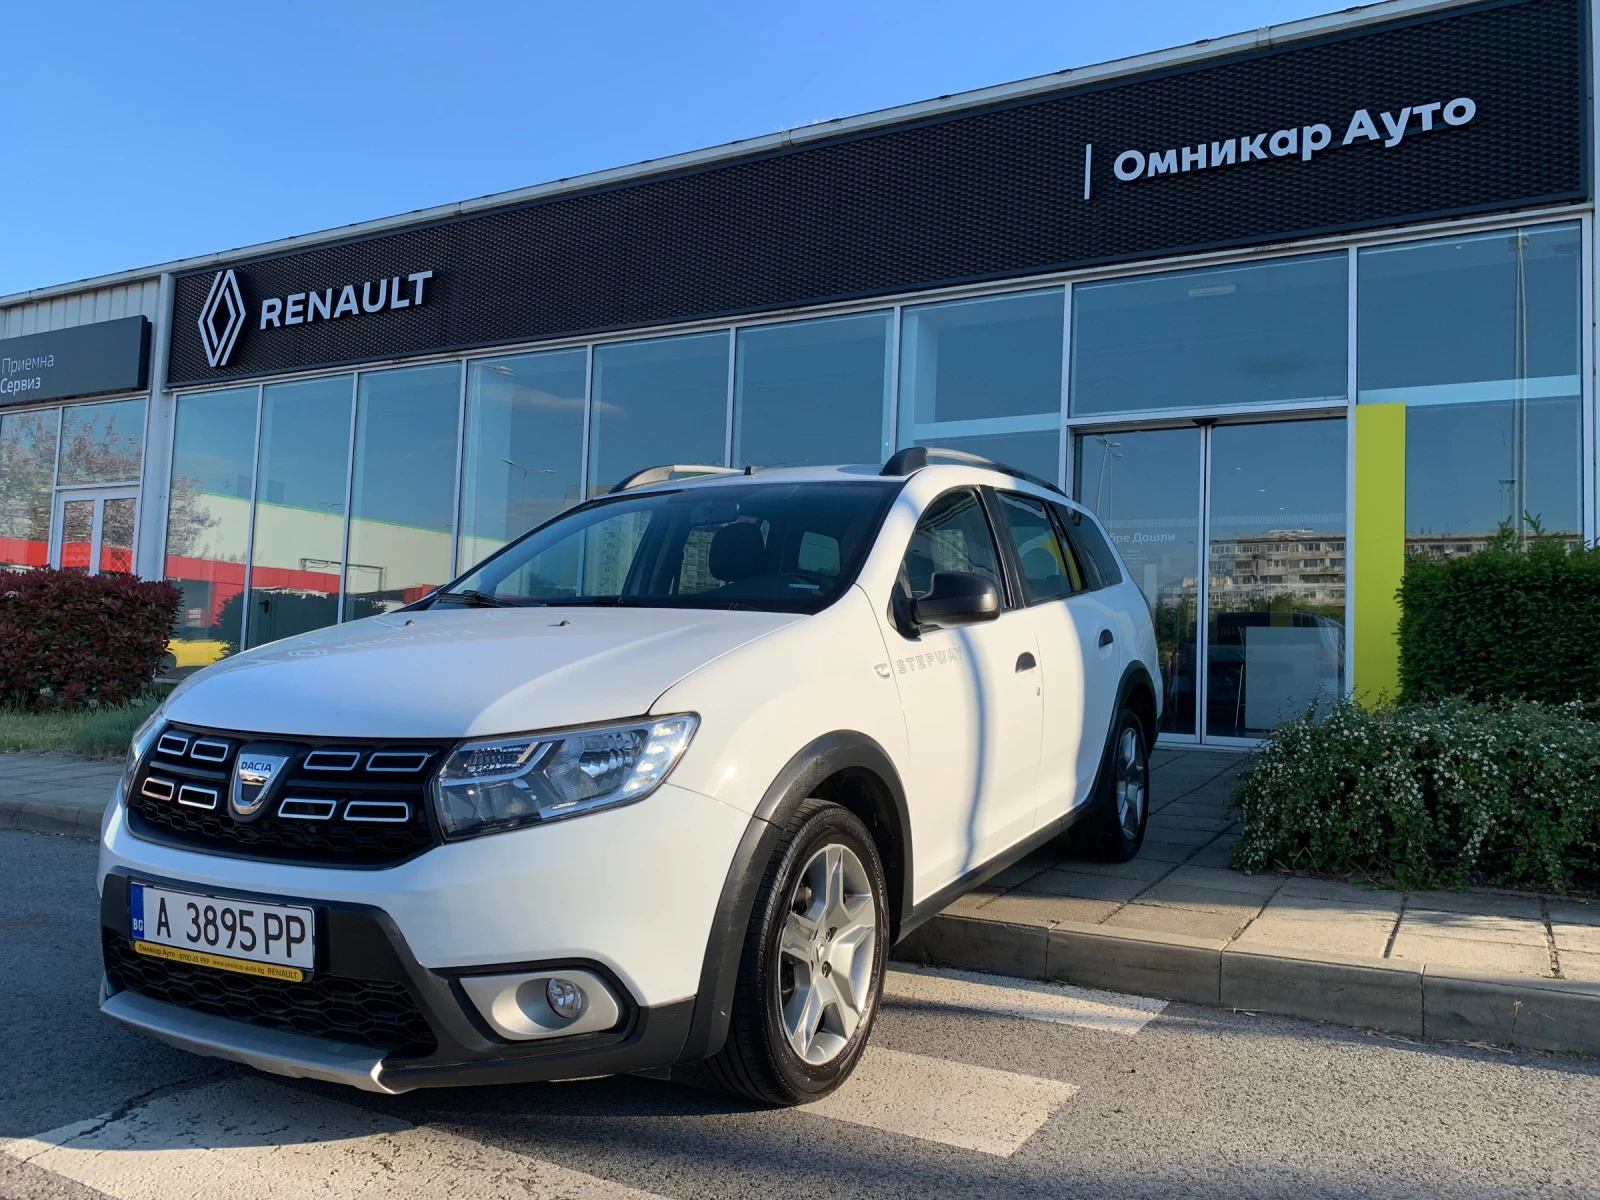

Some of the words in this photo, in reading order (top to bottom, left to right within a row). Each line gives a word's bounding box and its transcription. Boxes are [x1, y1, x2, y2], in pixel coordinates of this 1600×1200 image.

[1113, 122, 1332, 182] Омникар
[1341, 97, 1477, 148] Ауто
[259, 270, 433, 330] RENAULT
[2, 354, 54, 377] Приемна
[0, 377, 41, 396] Сервиз
[1109, 532, 1130, 545] бре
[1131, 532, 1176, 544] Дошли
[896, 646, 963, 675] STEPWAY
[240, 761, 272, 773] DACIA
[133, 918, 143, 932] BG
[267, 966, 298, 980] RENAULT
